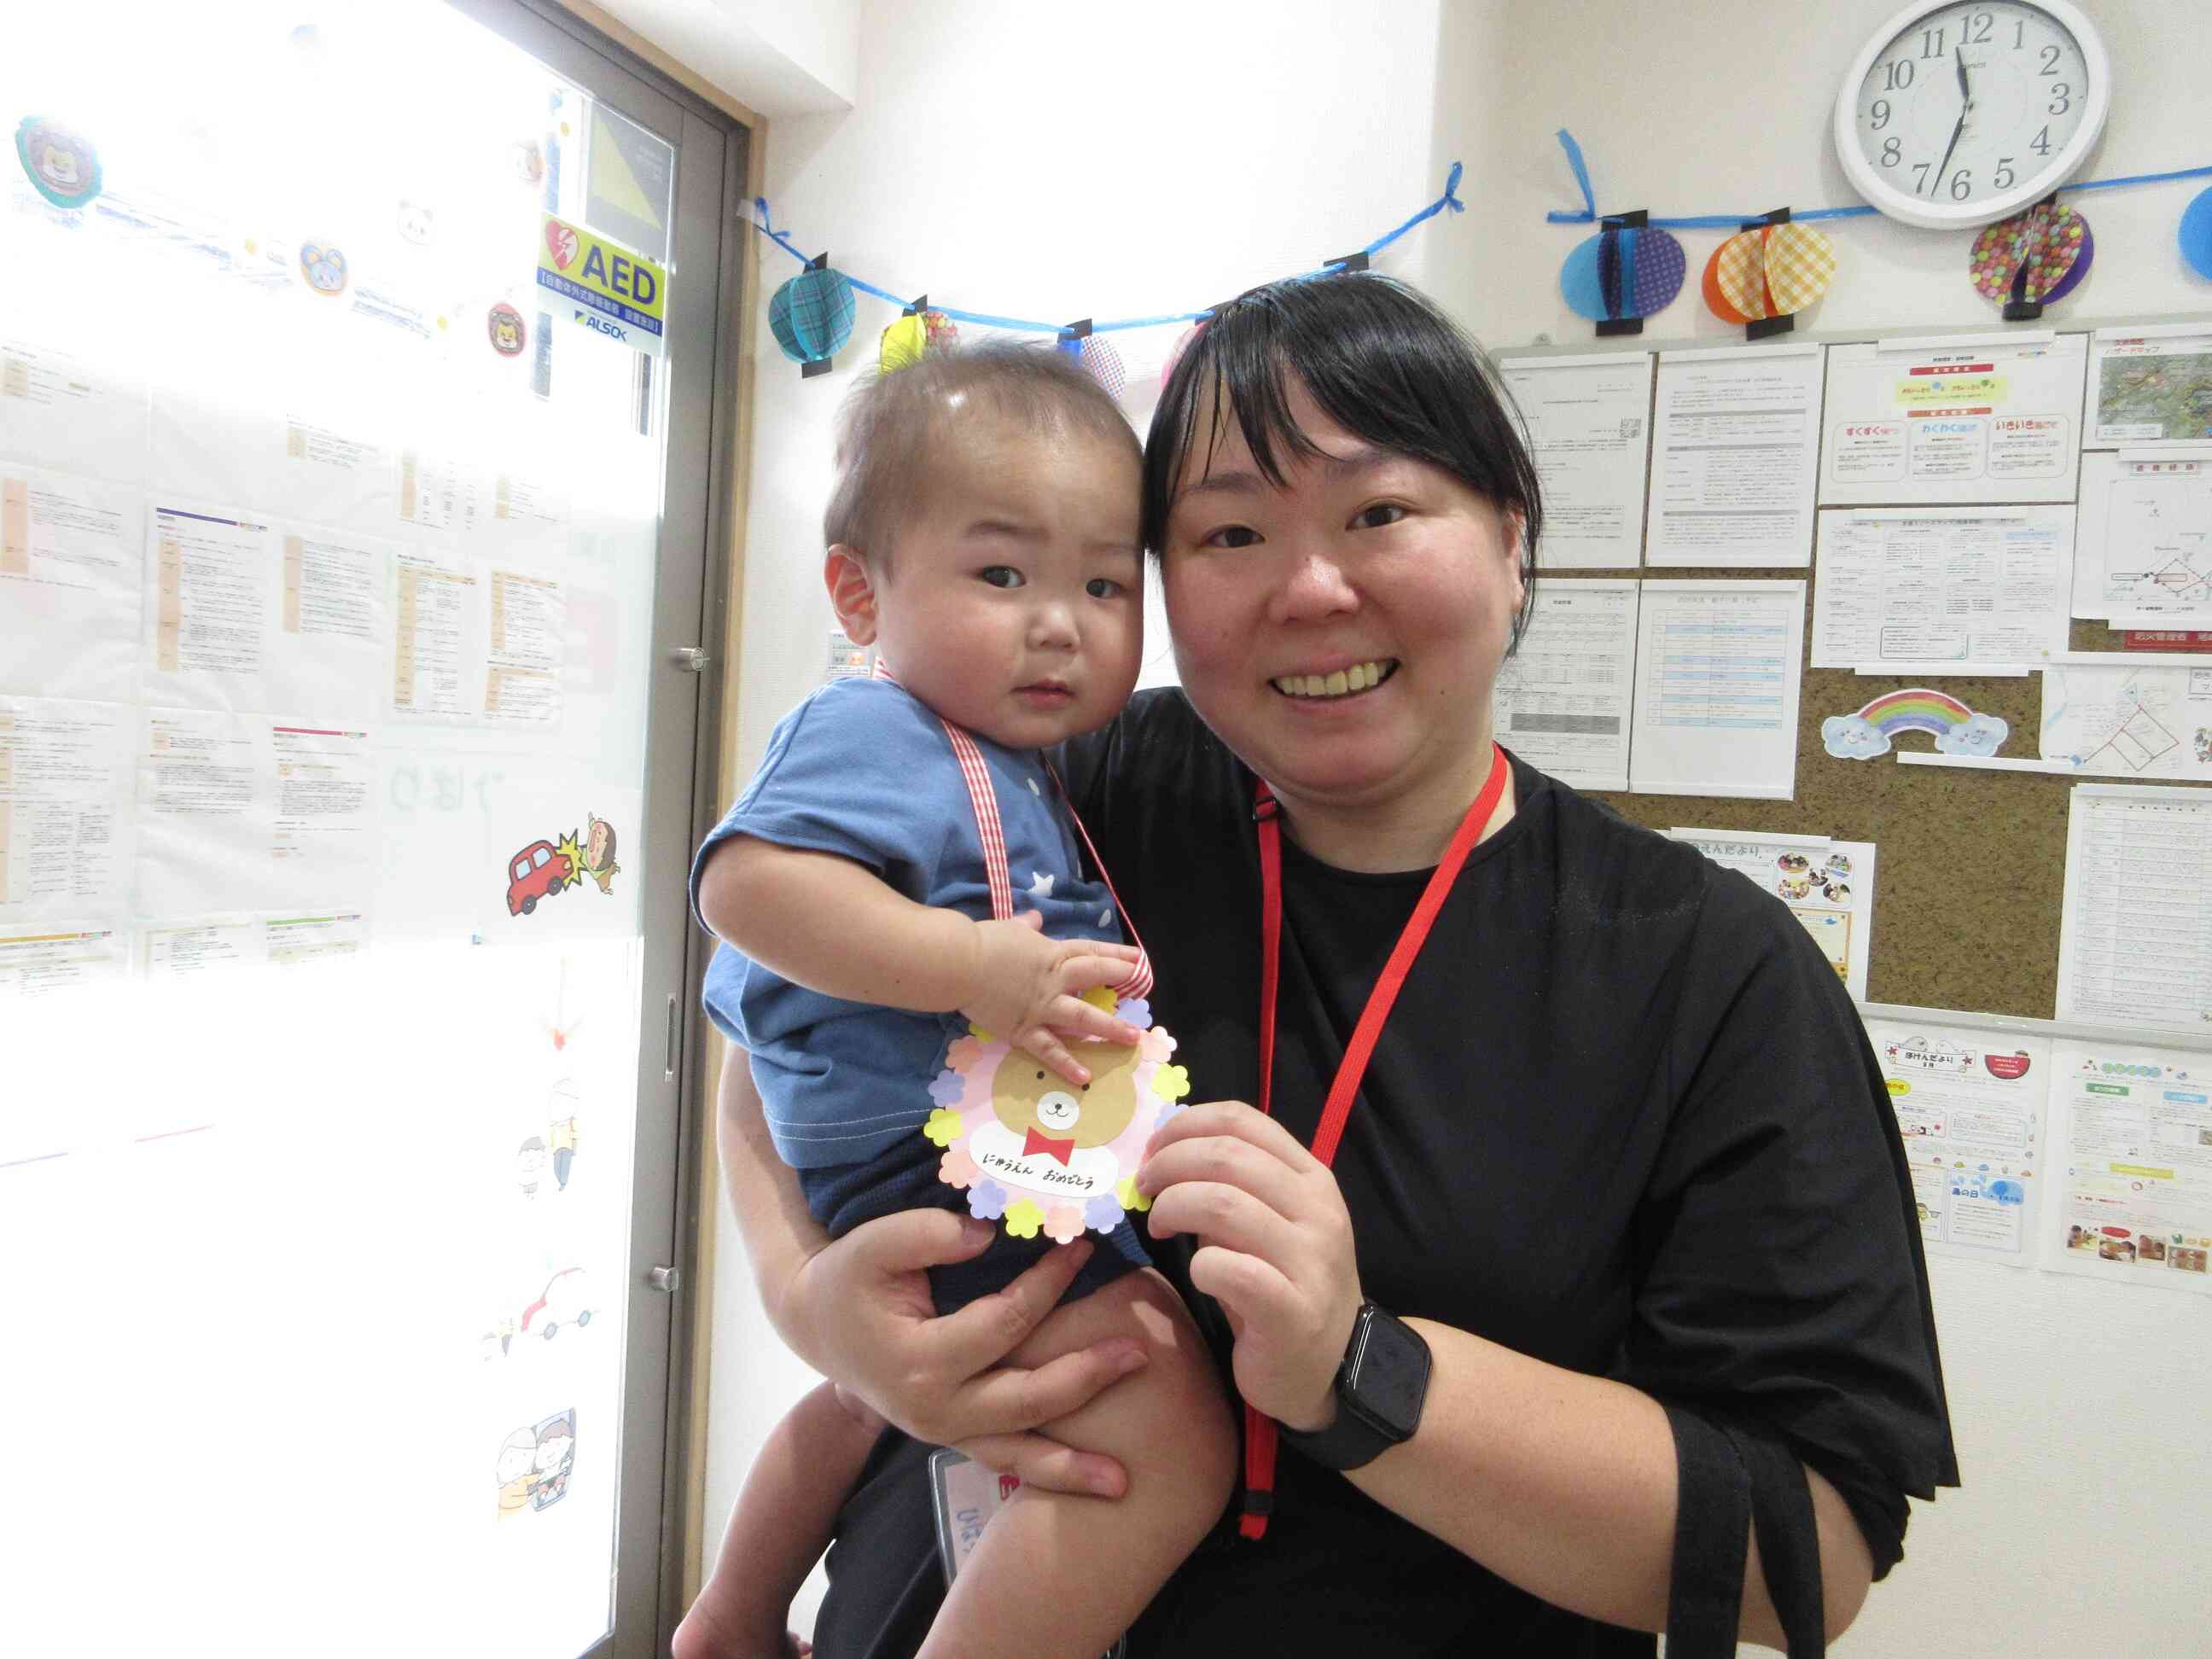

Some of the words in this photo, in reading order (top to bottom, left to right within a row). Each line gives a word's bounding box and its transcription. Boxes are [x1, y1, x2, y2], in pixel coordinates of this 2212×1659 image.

[1920, 28, 1945, 59] 11
[1959, 13, 1994, 44] 12
[2013, 20, 2023, 49] 1
[1884, 60, 1914, 90] 10
[2040, 46, 2060, 76] 2
[1870, 100, 1891, 130] 9
[2048, 84, 2069, 115] 3
[1881, 137, 1901, 167] 8
[2030, 125, 2051, 155] 4
[1912, 163, 1931, 194] 7
[1951, 170, 1970, 201] 6
[1994, 158, 2014, 189] 5
[581, 244, 655, 306] AED
[586, 317, 627, 341] ALSOK
[983, 1154, 1033, 1174] にゅうえん
[1043, 1170, 1093, 1190] おめでとう
